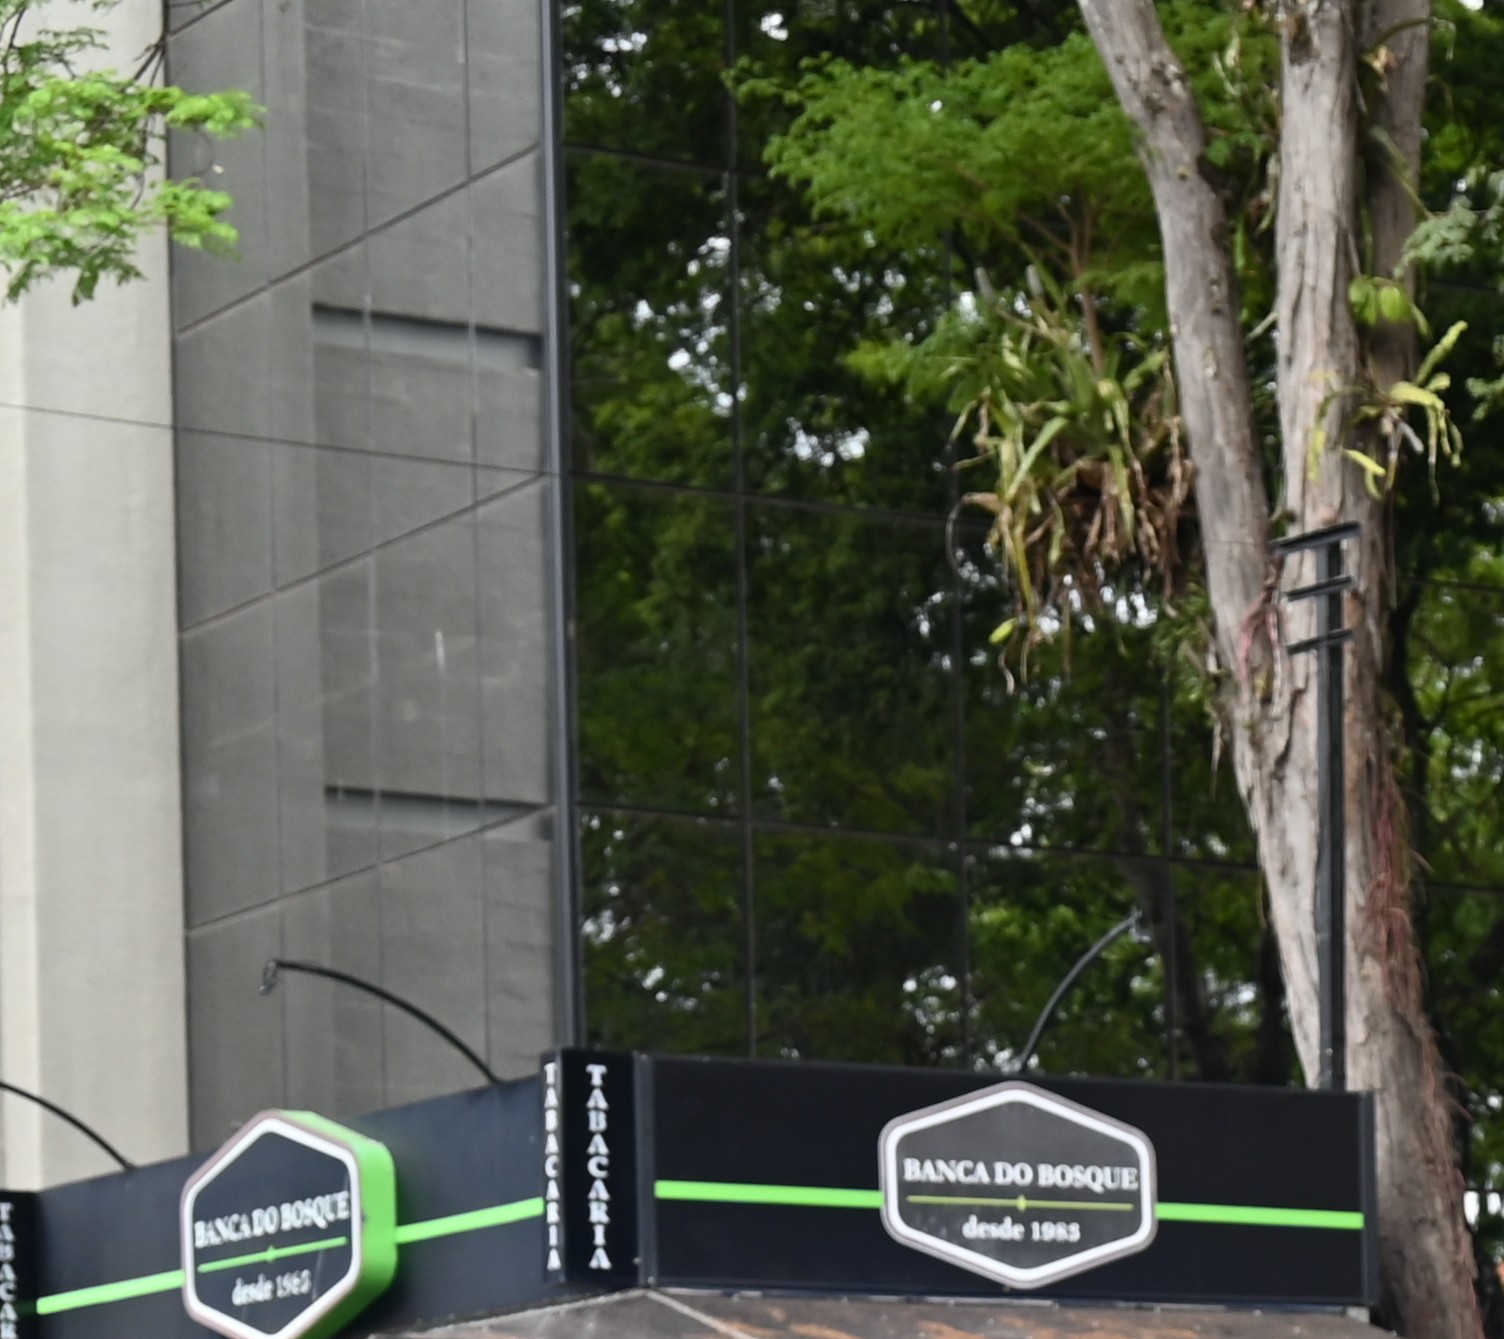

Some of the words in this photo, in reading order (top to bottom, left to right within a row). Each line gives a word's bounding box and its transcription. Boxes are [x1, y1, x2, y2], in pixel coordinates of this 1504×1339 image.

[544, 1062, 561, 1271] TABACARIA
[585, 1063, 613, 1270] TABACARIA
[903, 1157, 991, 1185] BANCA
[993, 1161, 1034, 1187] DO
[1036, 1163, 1139, 1194] BOSQUE
[194, 1213, 252, 1250] BANCA
[253, 1207, 277, 1236] DO
[280, 1190, 351, 1231] BOSQUE
[961, 1214, 1026, 1242] desde
[231, 1273, 273, 1308] desde
